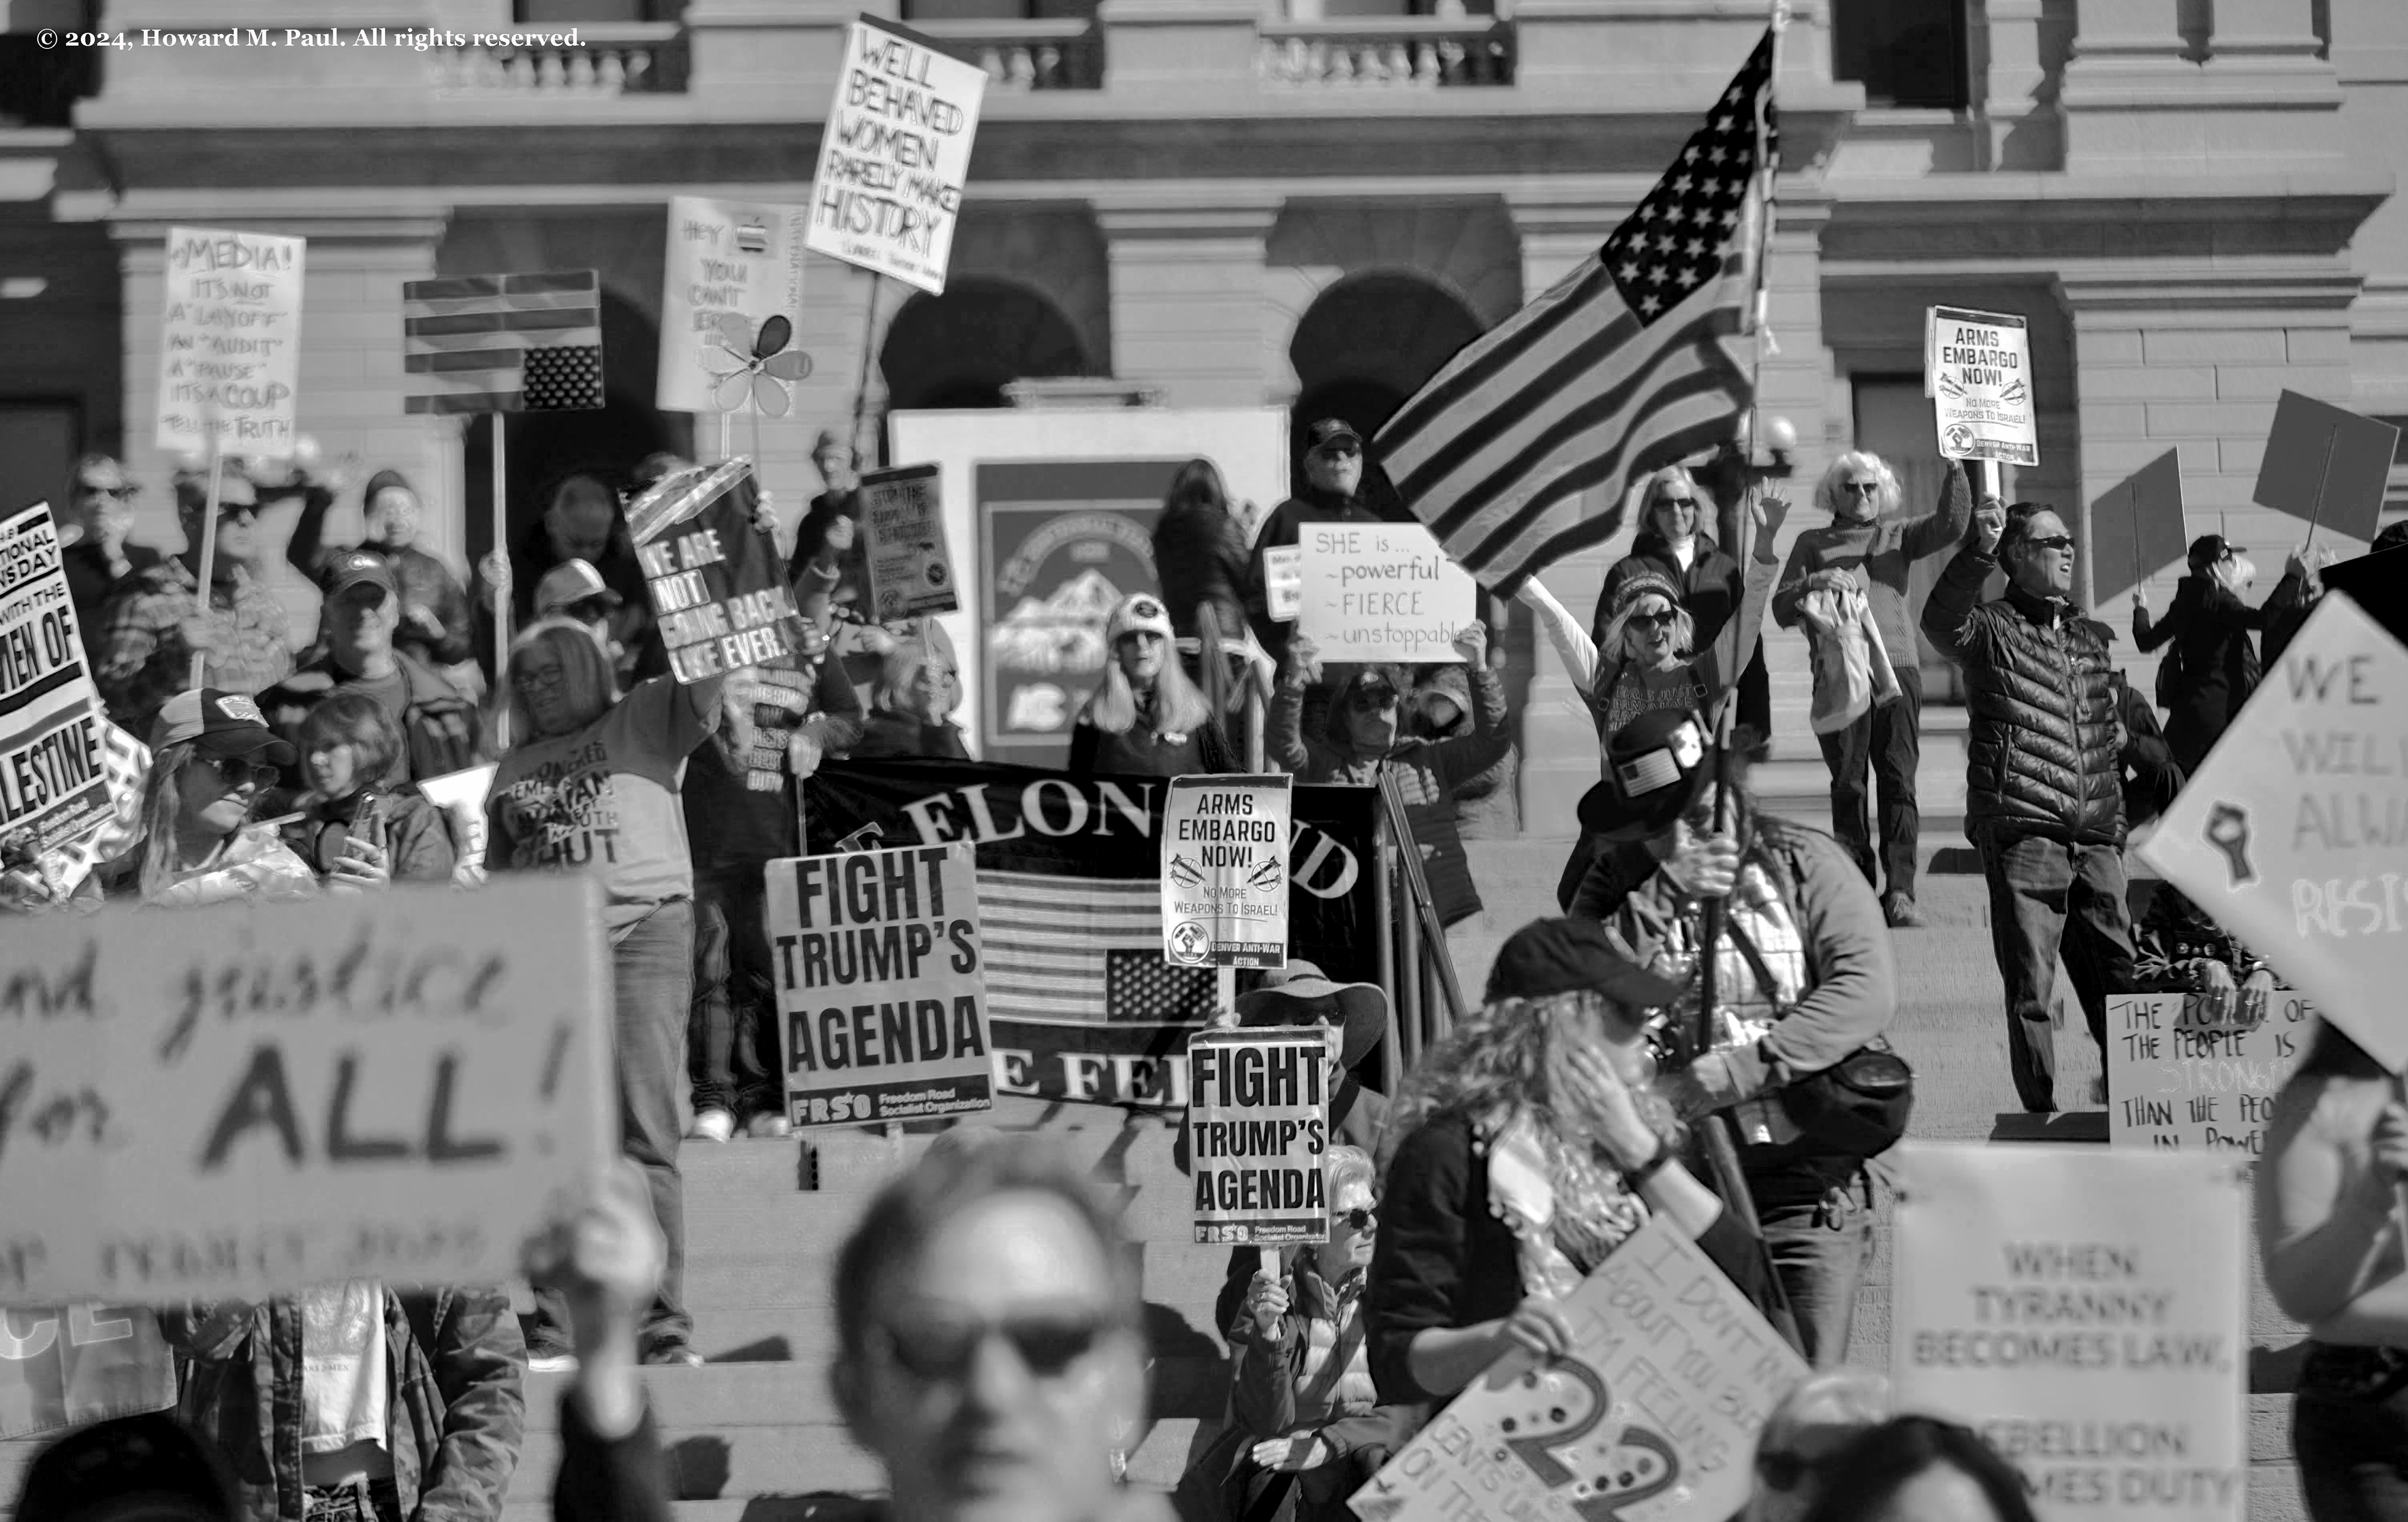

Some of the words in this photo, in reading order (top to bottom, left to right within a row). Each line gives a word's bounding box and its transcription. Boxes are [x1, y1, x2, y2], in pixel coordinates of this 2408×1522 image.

[860, 29, 935, 90] WELL
[848, 68, 963, 136] BEHAVED
[837, 108, 938, 171] WOMEN
[817, 182, 941, 258] HISTORY
[1955, 327, 1999, 347] ARMS
[1943, 346, 2018, 369] EMBARGO
[1962, 367, 2003, 387] NOW!
[677, 529, 727, 569] ARE
[1316, 532, 1361, 554] SHE
[33, 581, 66, 607] THE
[654, 571, 704, 613] NOT
[1342, 591, 1424, 616] FIERCE
[42, 605, 74, 668] OF
[721, 626, 789, 669] EVER.
[2283, 652, 2380, 706] WE
[1196, 793, 1254, 815] ARMS
[1179, 819, 1275, 843] EMBARGO
[1201, 845, 1253, 869] NOW!
[795, 847, 949, 929] FIGHT
[776, 919, 977, 990] TRUMP'S
[2109, 1001, 2163, 1030] THE
[2284, 999, 2315, 1023] OF
[788, 995, 985, 1074] AGENDA
[2122, 1033, 2160, 1062] THE
[2173, 1028, 2247, 1060] PEOPLE
[2274, 1031, 2296, 1058] IS
[927, 1087, 956, 1100] Road
[1192, 1046, 1326, 1107] FIGHT
[2120, 1094, 2173, 1128] THAN
[2185, 1096, 2219, 1123] THE
[1193, 1119, 1324, 1158] TRUMP'S
[1195, 1168, 1325, 1211] AGENDA
[1255, 1225, 1287, 1235] Freedom
[1287, 1225, 1307, 1234] Road
[2004, 1242, 2138, 1279] WHEN
[1969, 1286, 2173, 1324] TYRANNY
[1913, 1330, 2115, 1369] BECOMES
